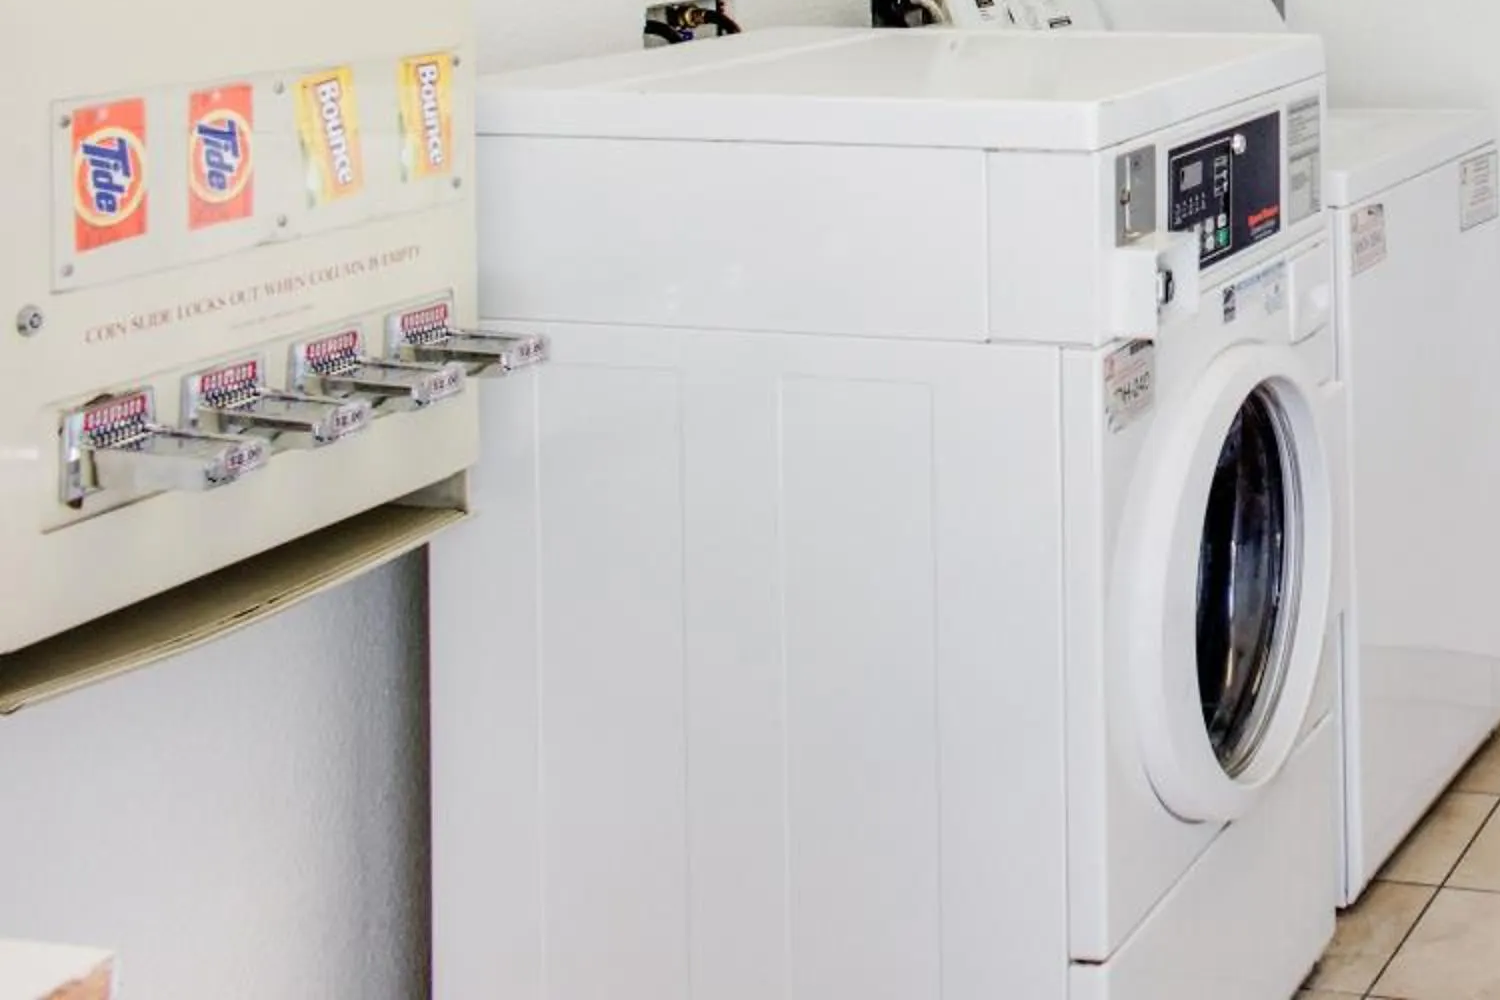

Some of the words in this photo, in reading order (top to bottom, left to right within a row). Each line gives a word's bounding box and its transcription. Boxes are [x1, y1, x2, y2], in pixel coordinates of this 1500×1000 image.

[317, 80, 354, 185] Bounce
[417, 63, 444, 166] Bounce
[81, 137, 132, 213] Tide
[197, 119, 239, 191] Tide
[84, 321, 128, 343] COIN
[229, 286, 260, 307] OUT
[263, 276, 306, 297] WHEN
